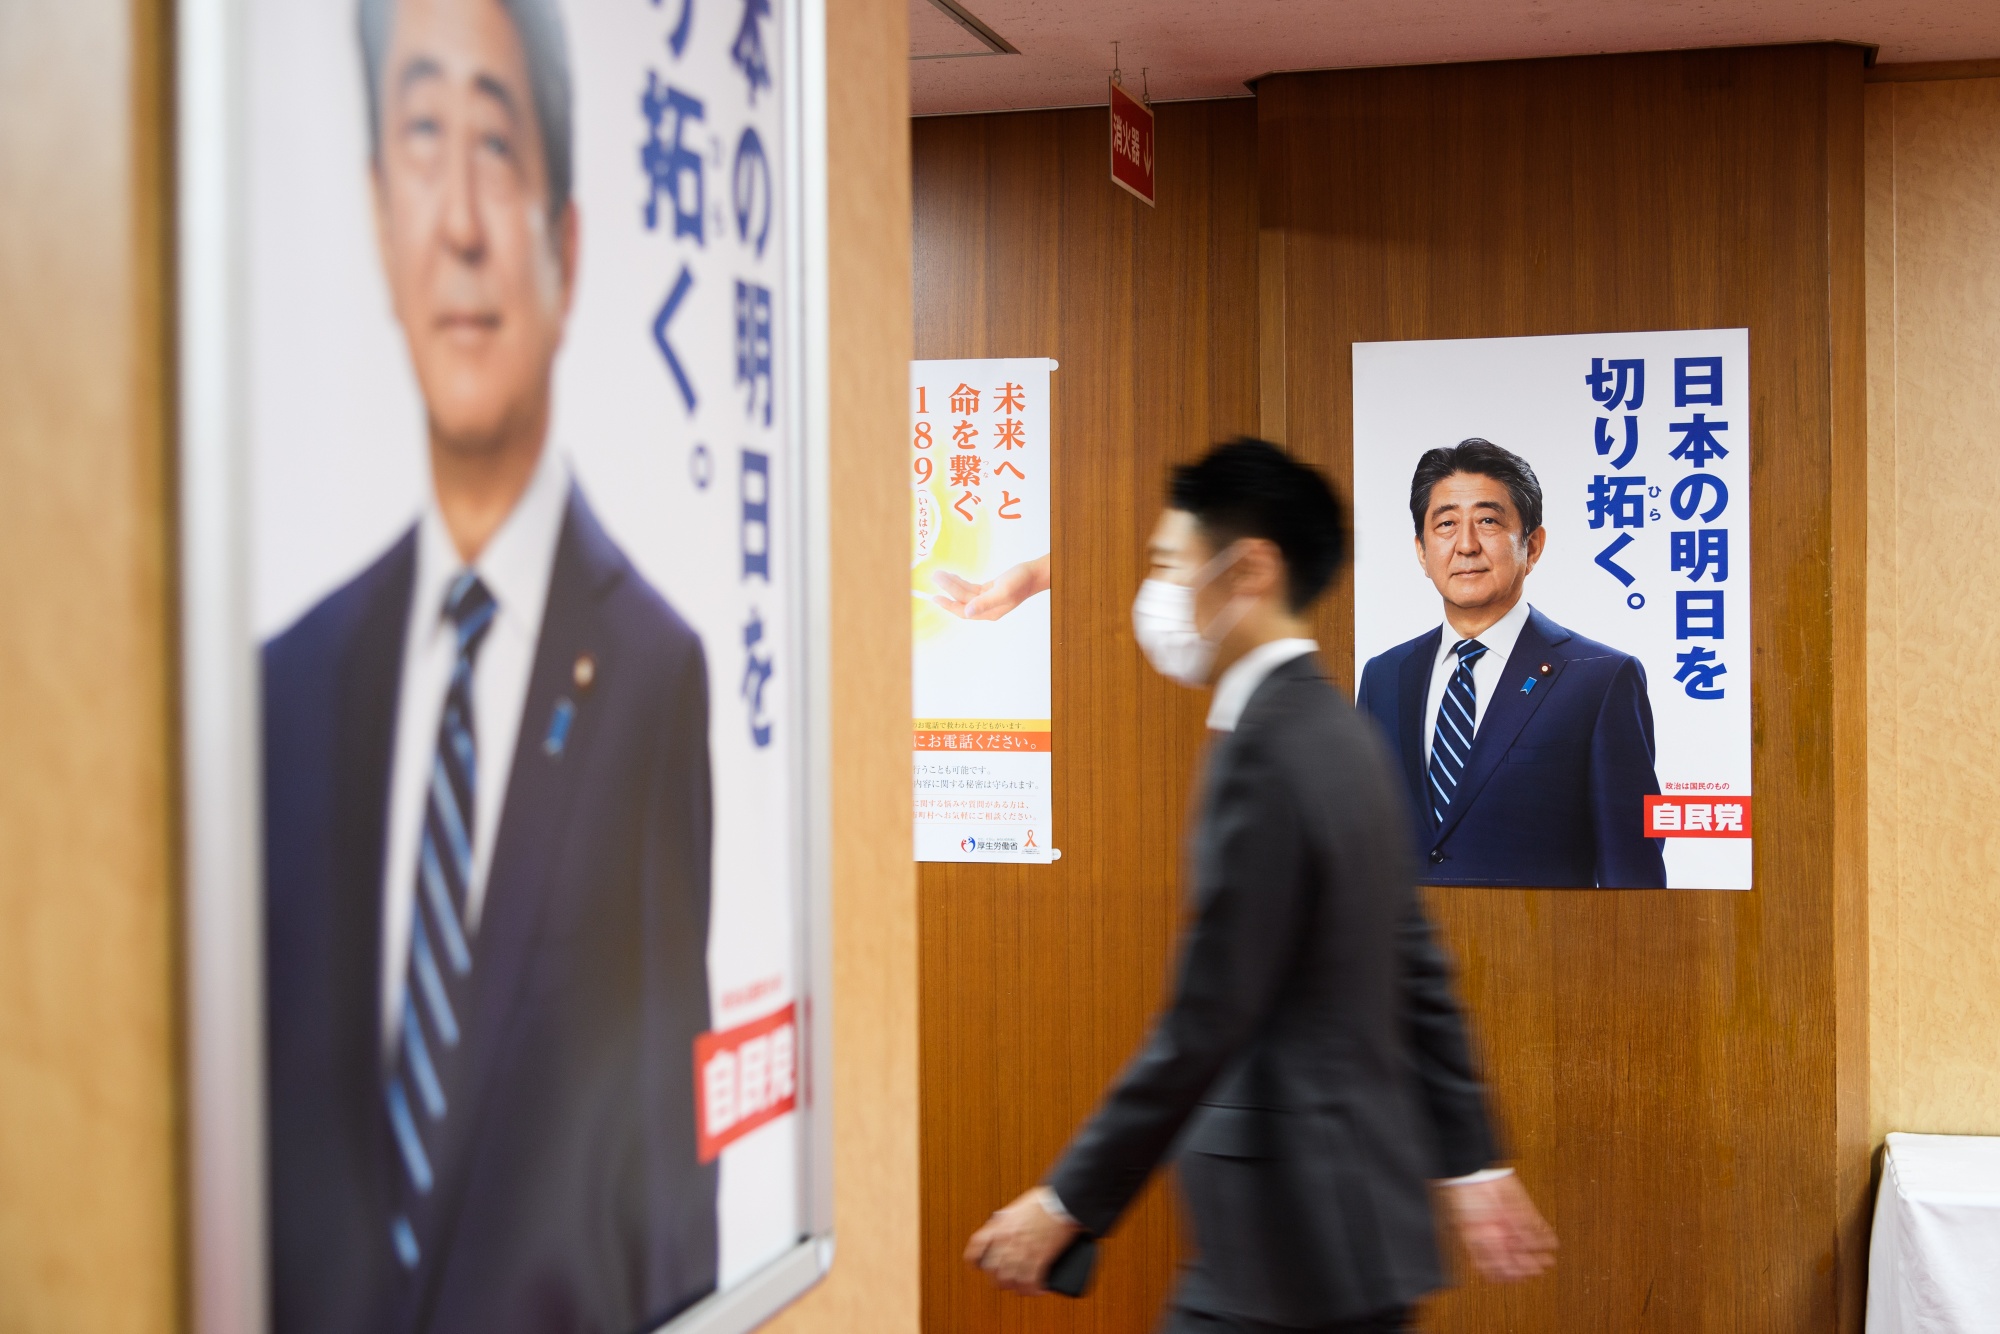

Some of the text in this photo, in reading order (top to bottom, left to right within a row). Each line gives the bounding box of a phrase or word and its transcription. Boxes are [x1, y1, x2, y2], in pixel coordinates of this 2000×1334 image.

[1113, 113, 1140, 167] 消火器
[948, 382, 982, 522] 命を繋ぐ
[993, 382, 1026, 520] 未来へと
[1585, 357, 1645, 611] 切り拓く。
[1648, 486, 1662, 522] ひら
[1669, 356, 1729, 700] 日本の明日を
[913, 733, 1037, 750] にお電話ください。
[1665, 782, 1730, 790] 政治は国民のもの
[1652, 803, 1743, 831] 自民党
[977, 841, 1018, 850] 厚生労働省
